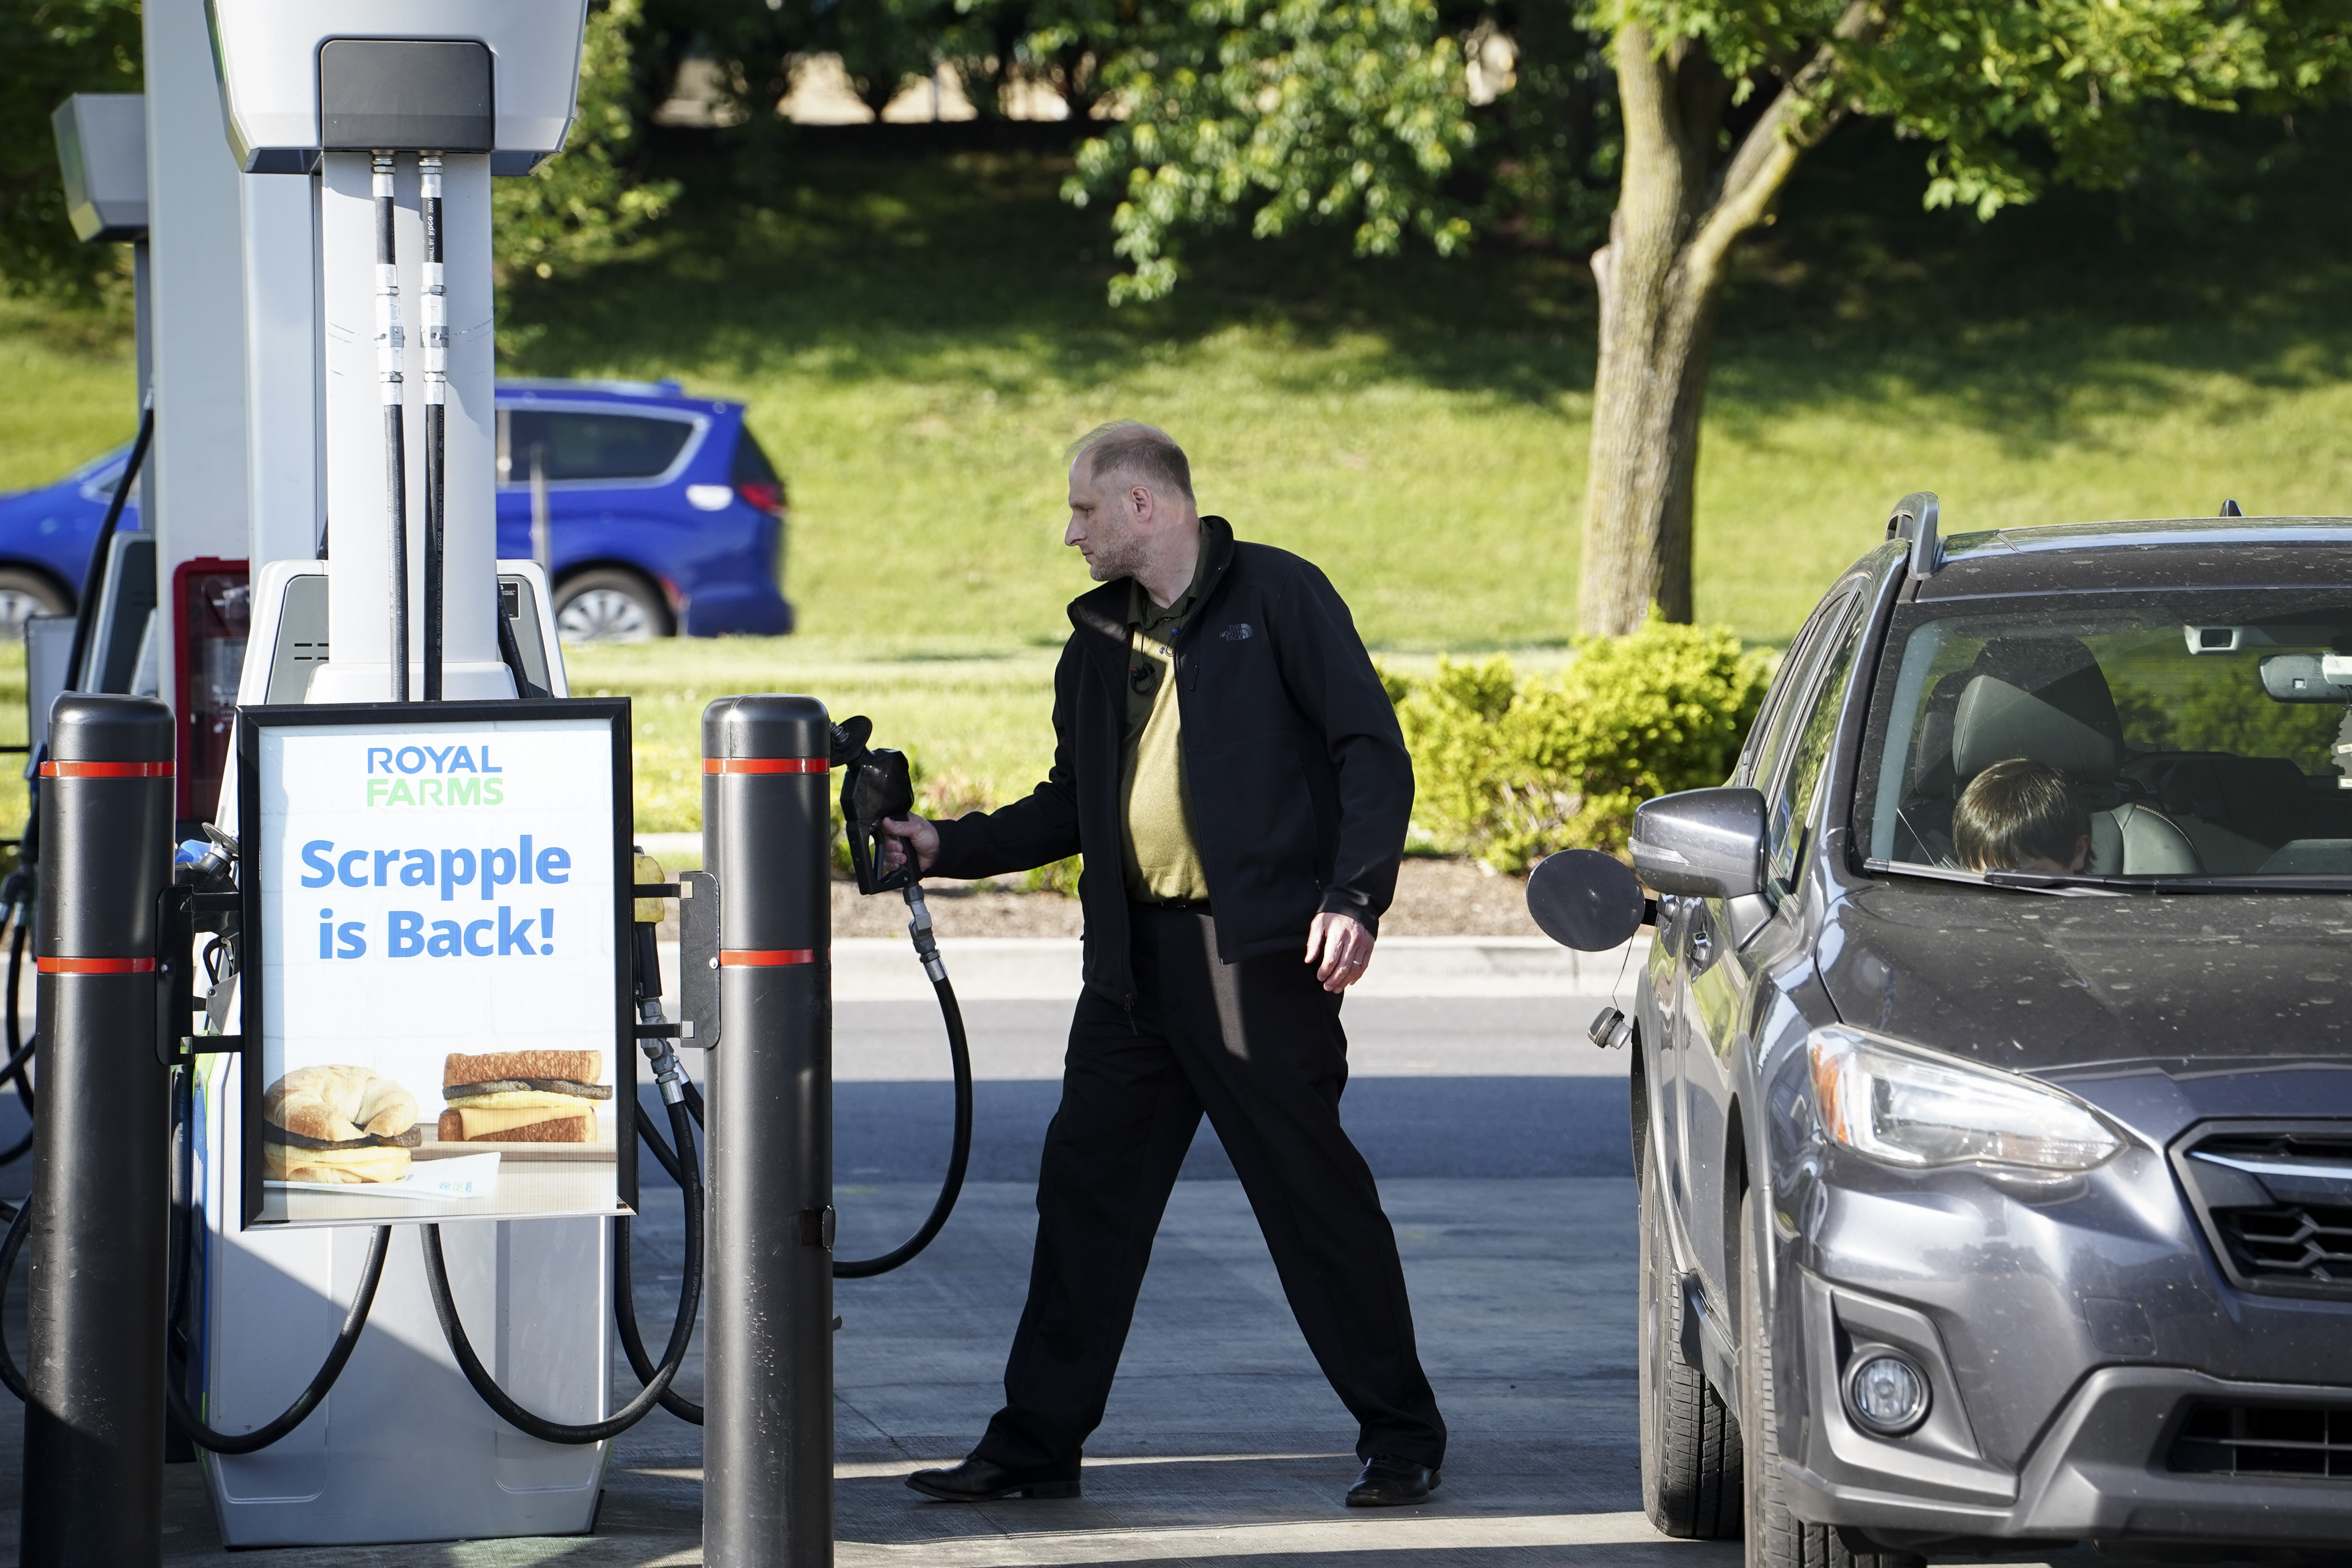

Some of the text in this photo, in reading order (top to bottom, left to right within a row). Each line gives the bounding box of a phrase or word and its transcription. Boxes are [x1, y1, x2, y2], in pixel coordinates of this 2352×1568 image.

[1220, 629, 1242, 638] NORTH
[367, 745, 502, 774] ROYAL
[367, 777, 503, 807] FARMS
[301, 834, 571, 901] Scrapple
[320, 906, 554, 959] is Back!
